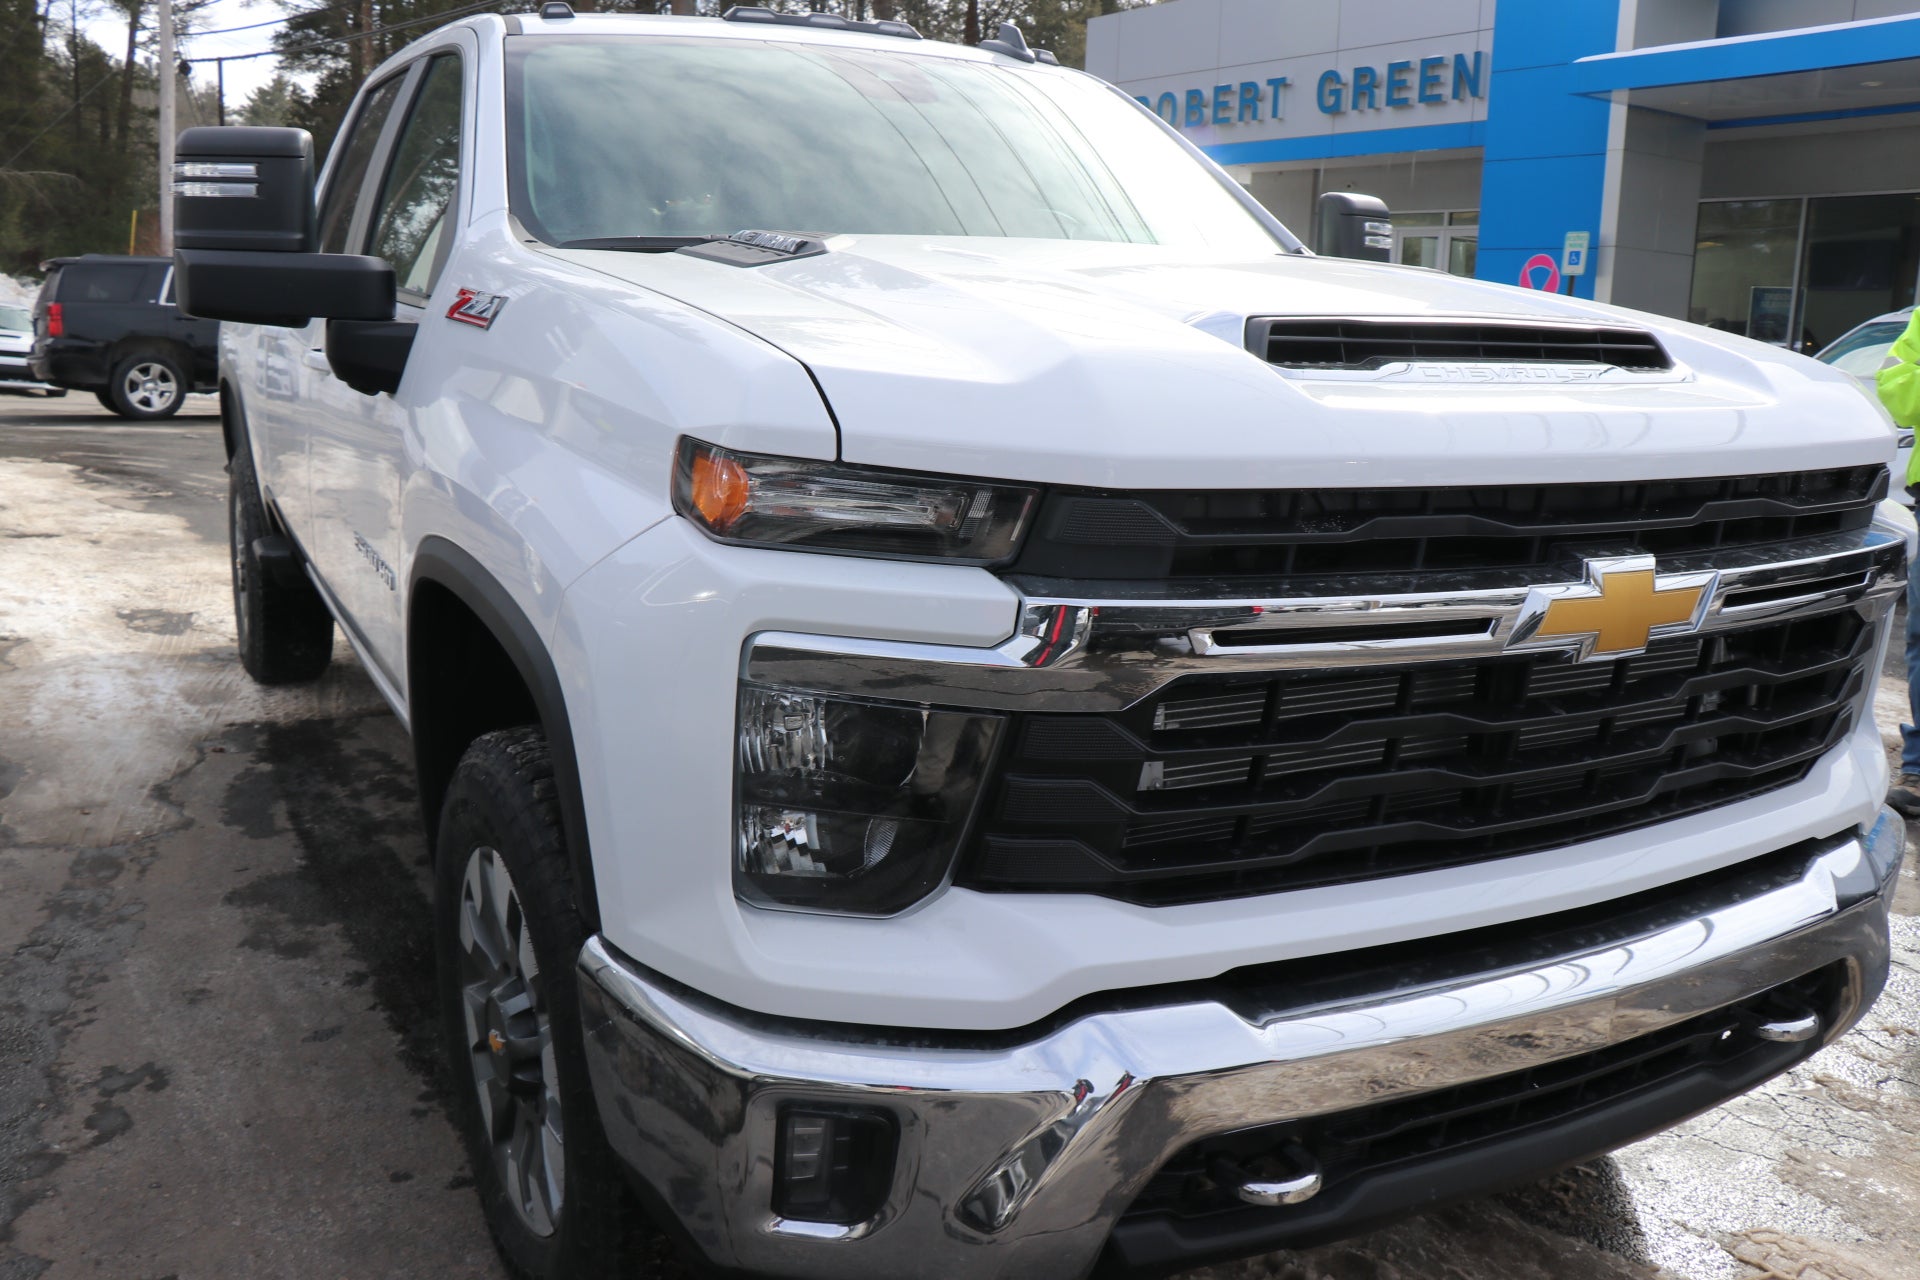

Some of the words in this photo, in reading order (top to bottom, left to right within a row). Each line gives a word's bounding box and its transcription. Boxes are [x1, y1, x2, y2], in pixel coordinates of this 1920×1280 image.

[1317, 51, 1482, 114] GREEN
[445, 288, 509, 331] Z71
[1418, 366, 1601, 380] CHEVROLET
